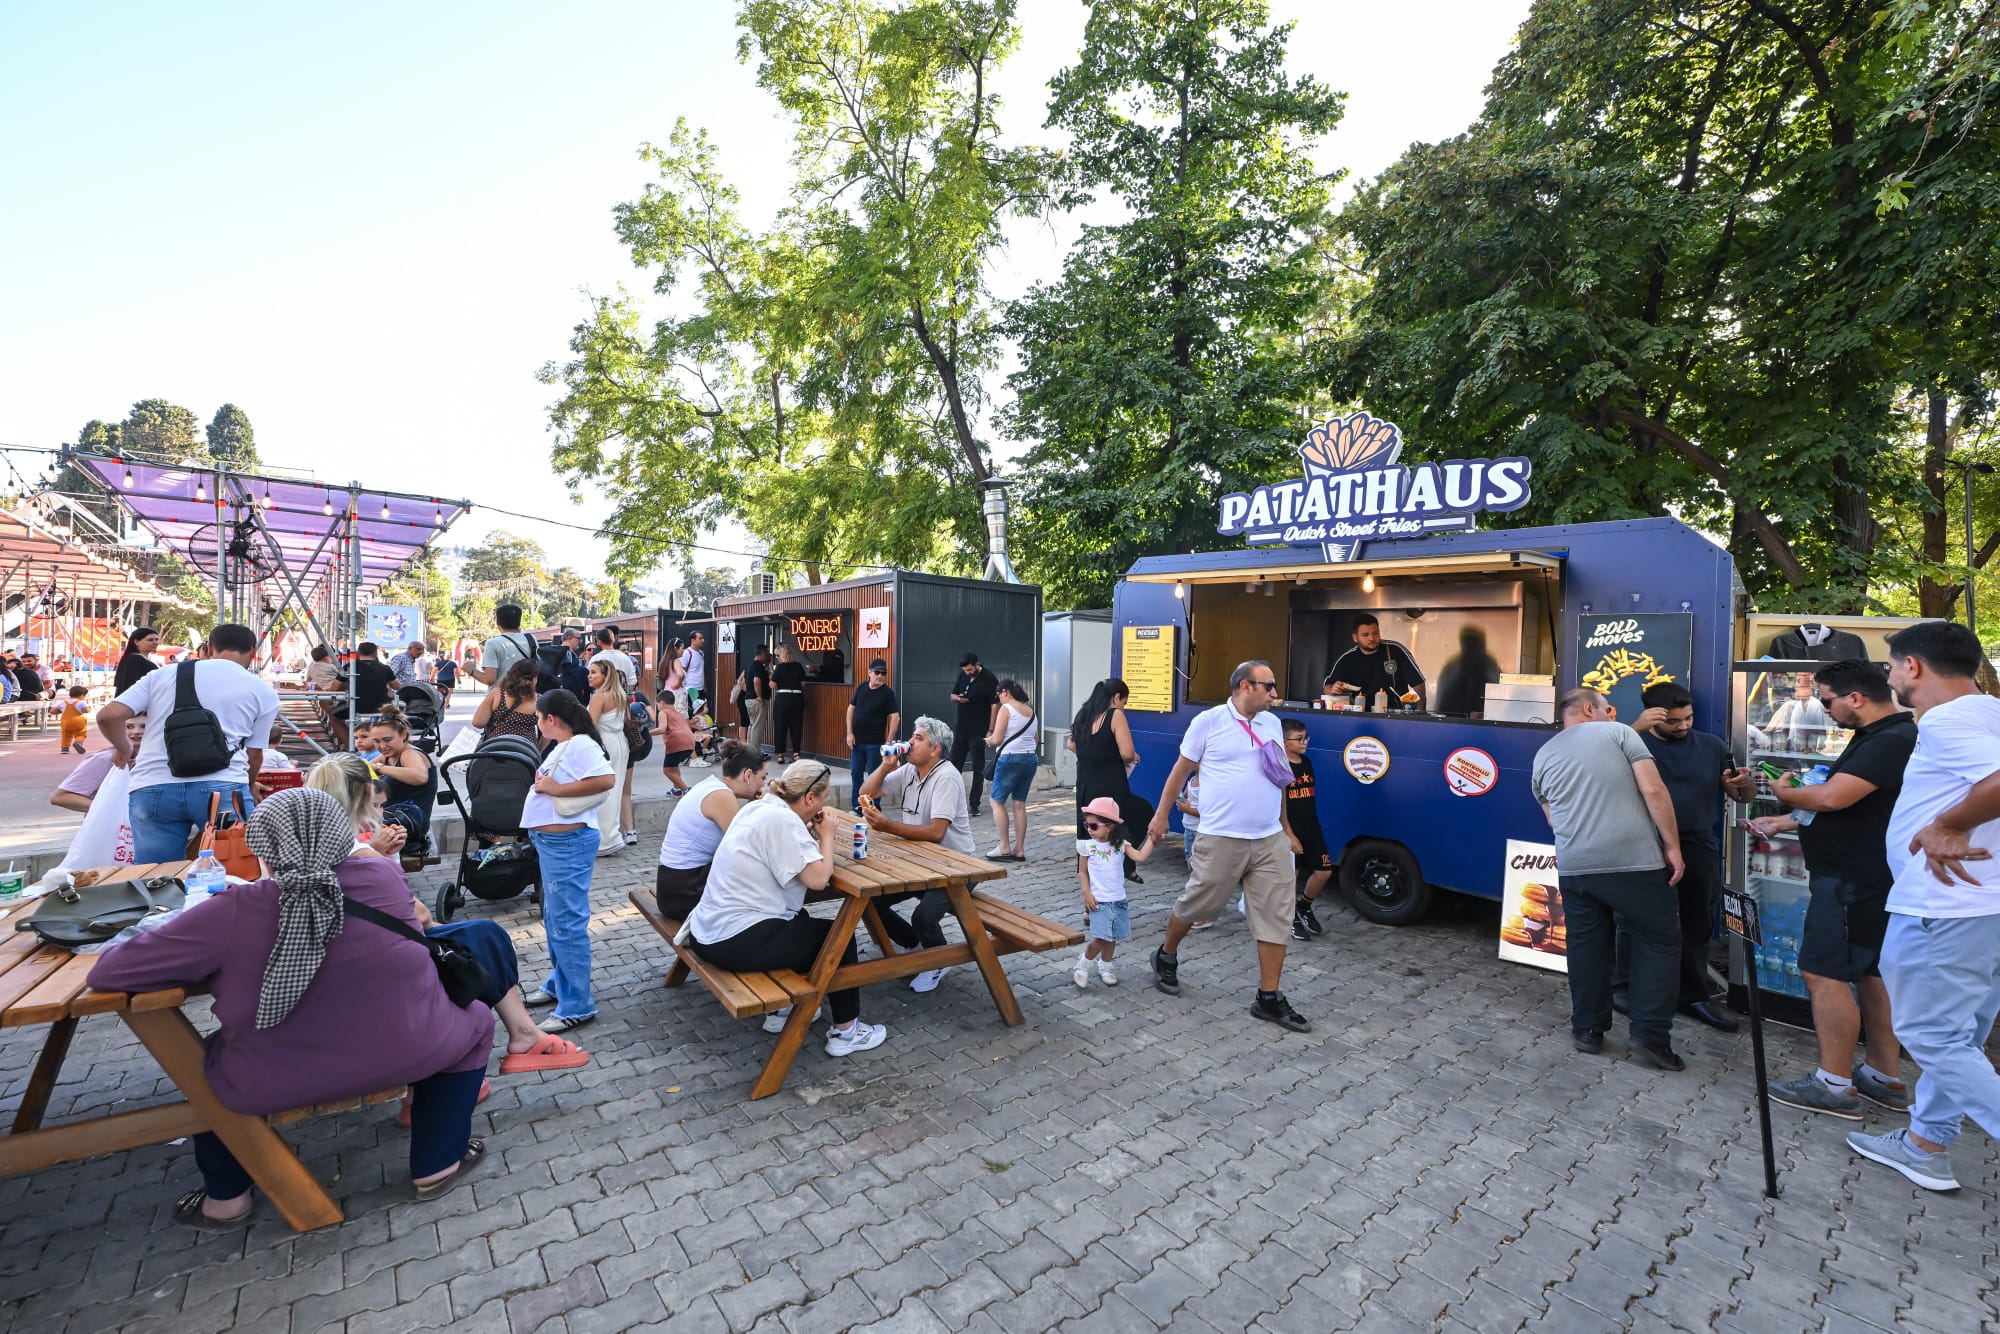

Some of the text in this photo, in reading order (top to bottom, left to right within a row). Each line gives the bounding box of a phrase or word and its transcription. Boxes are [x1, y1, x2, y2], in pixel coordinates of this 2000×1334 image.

[1220, 461, 1525, 531] PATATHAUS
[1284, 517, 1422, 543] Dutch Street Fries
[791, 616, 841, 635] DÖNERCİ
[1593, 619, 1638, 637] BOLD
[796, 635, 837, 652] VEDAT
